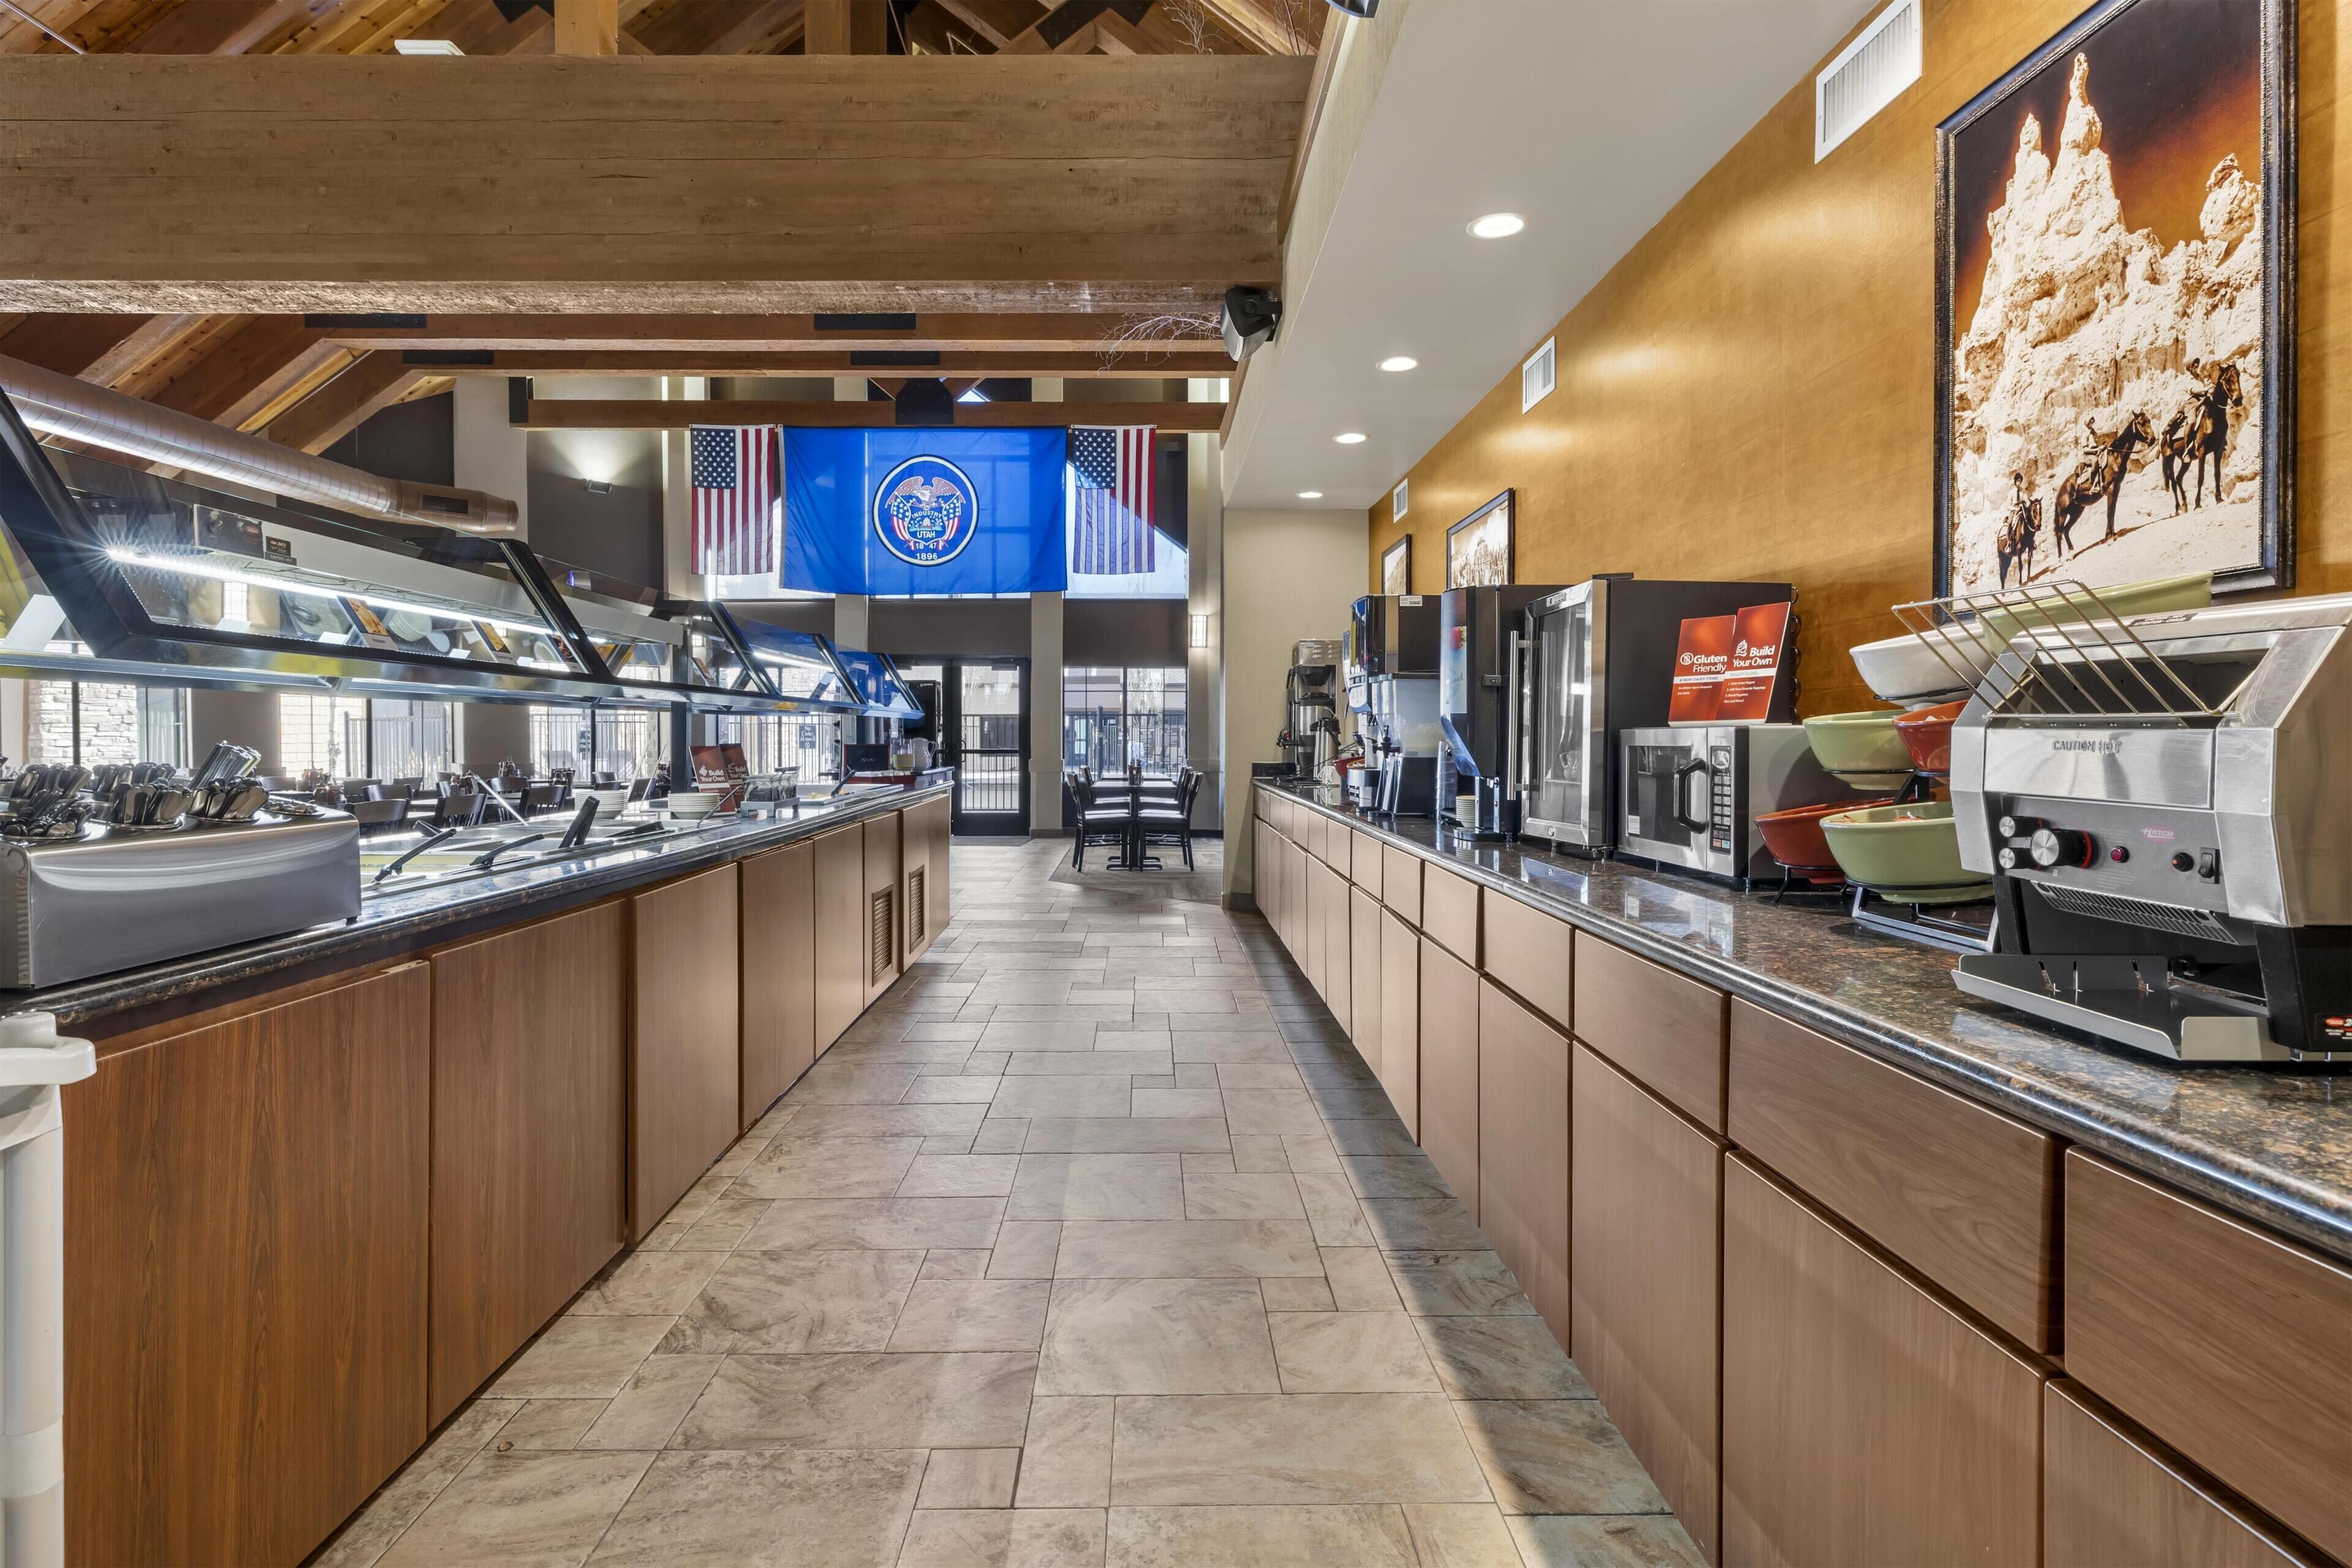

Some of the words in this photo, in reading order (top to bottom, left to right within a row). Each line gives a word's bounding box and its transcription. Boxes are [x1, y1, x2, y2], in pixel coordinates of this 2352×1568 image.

[1750, 646, 1775, 657] Build
[1694, 655, 1727, 664] Gluten
[1732, 658, 1751, 668] Your
[1751, 657, 1773, 666] Own
[1693, 663, 1727, 673] Friendly
[2053, 740, 2095, 752] CAUTION
[2140, 827, 2175, 839] HATCO
